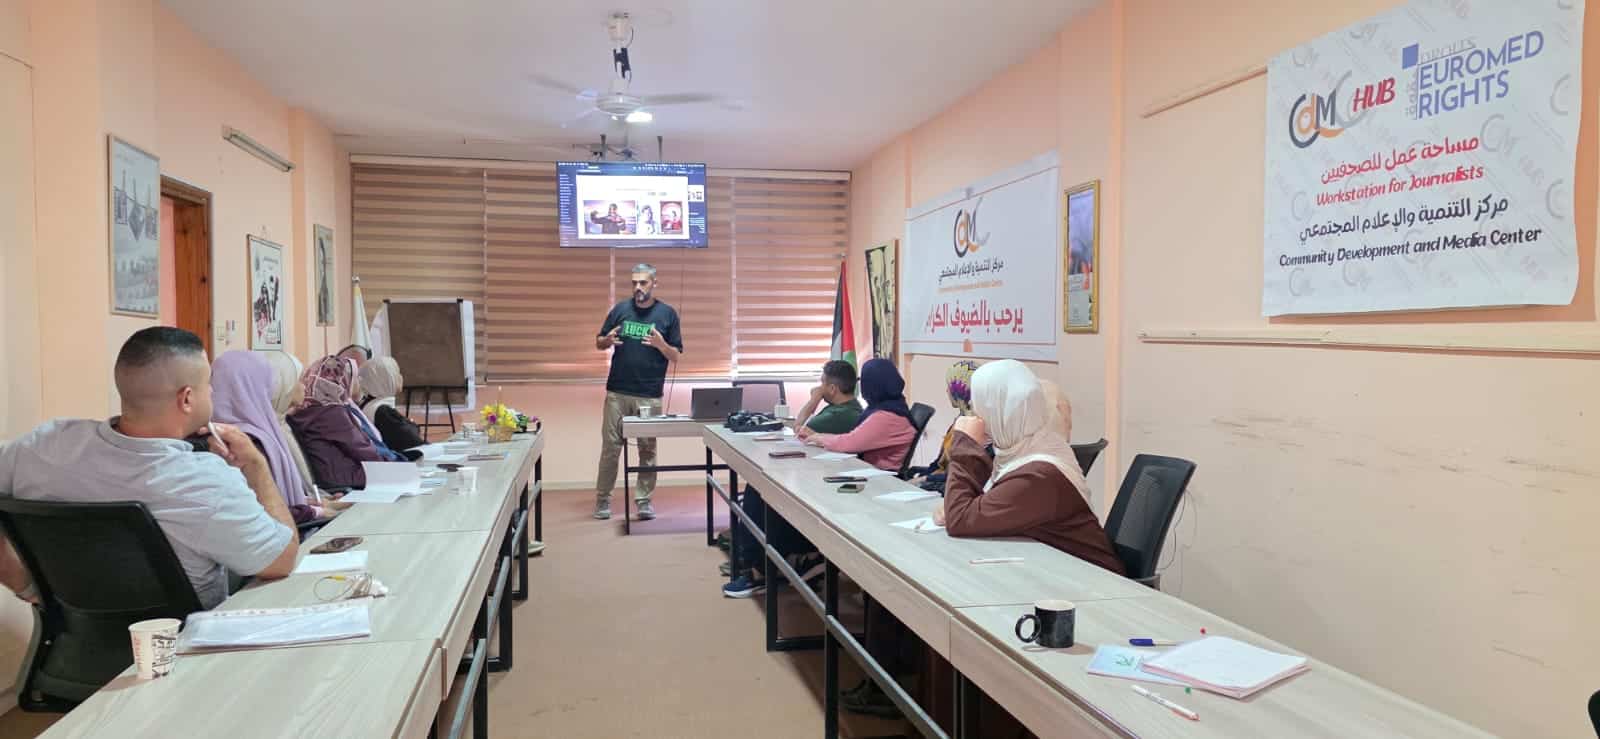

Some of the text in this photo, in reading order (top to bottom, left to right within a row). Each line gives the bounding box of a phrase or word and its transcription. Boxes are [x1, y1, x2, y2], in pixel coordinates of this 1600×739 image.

[1419, 30, 1545, 91] EUROMED
[1352, 77, 1396, 112] HUB
[1418, 69, 1510, 119] RIGHTS
[1320, 136, 1479, 185] مساحة عمل للصحفيين
[1316, 165, 1484, 206] Workstation for Journalists
[1299, 193, 1509, 246] مركز التنمية والإعلام المجتمعي
[1279, 227, 1542, 267] Community Development and Media Center
[950, 299, 991, 334] بالضيوف
[994, 307, 1024, 334] يرحب
